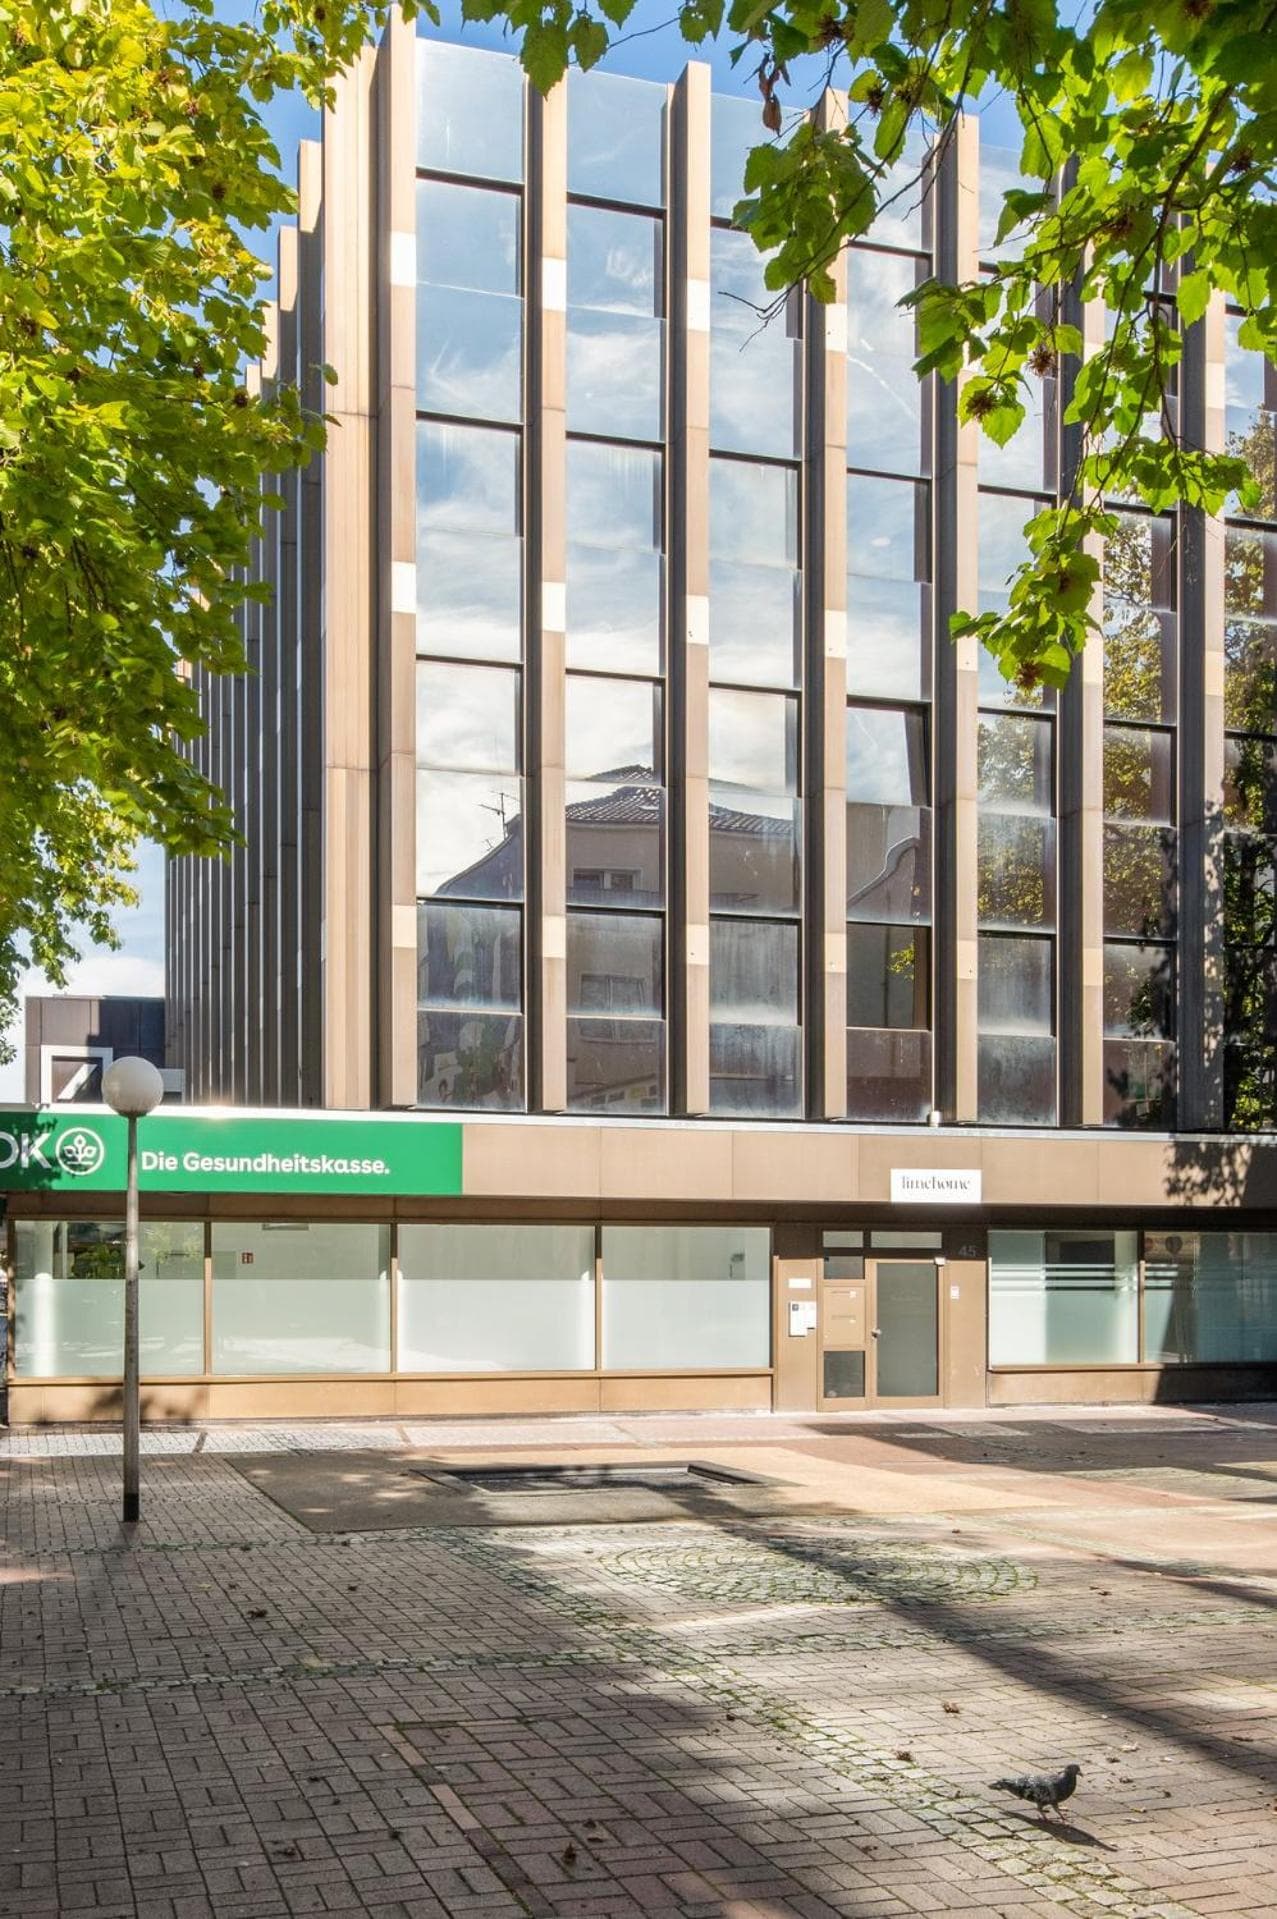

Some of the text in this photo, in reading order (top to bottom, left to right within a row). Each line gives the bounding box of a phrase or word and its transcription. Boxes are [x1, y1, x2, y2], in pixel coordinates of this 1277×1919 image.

[141, 1151, 390, 1175] Die Gesundheitskasse.
[902, 1175, 971, 1190] limehome
[958, 1244, 977, 1257] 45
